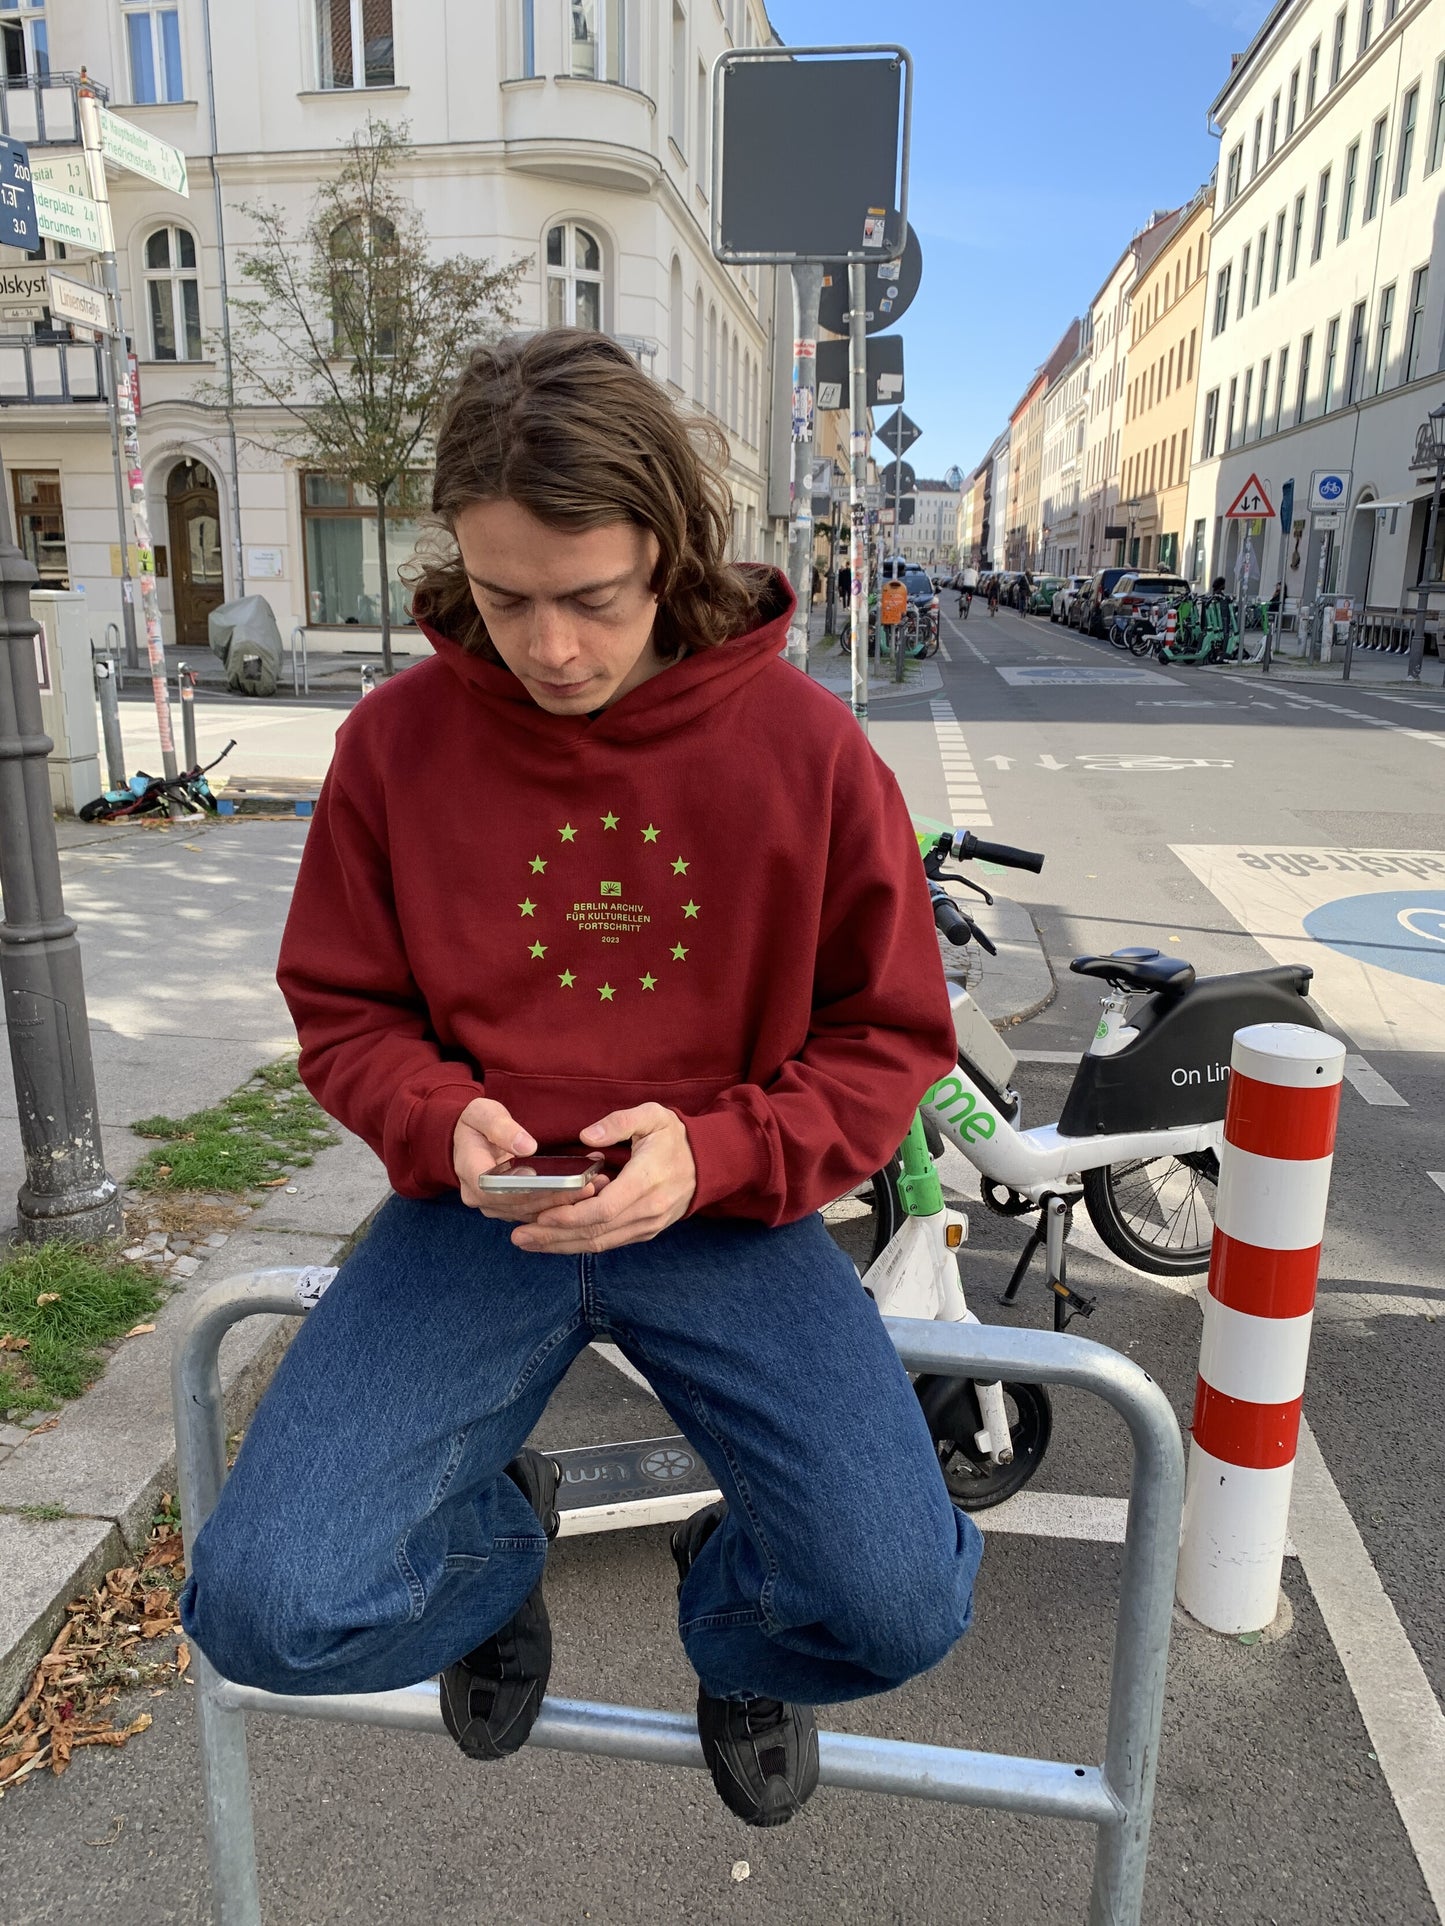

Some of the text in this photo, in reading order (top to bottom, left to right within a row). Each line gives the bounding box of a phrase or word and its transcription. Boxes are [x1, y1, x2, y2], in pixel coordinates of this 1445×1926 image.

[13, 163, 31, 182] 200
[67, 163, 80, 177] 1.3
[13, 218, 27, 235] 3.0
[573, 902, 644, 913] BERLIN ARCHIV
[566, 911, 651, 923] FÜR KULTURELLEN
[578, 922, 642, 932] FORTSCHRITT
[1171, 1068, 1201, 1087] On
